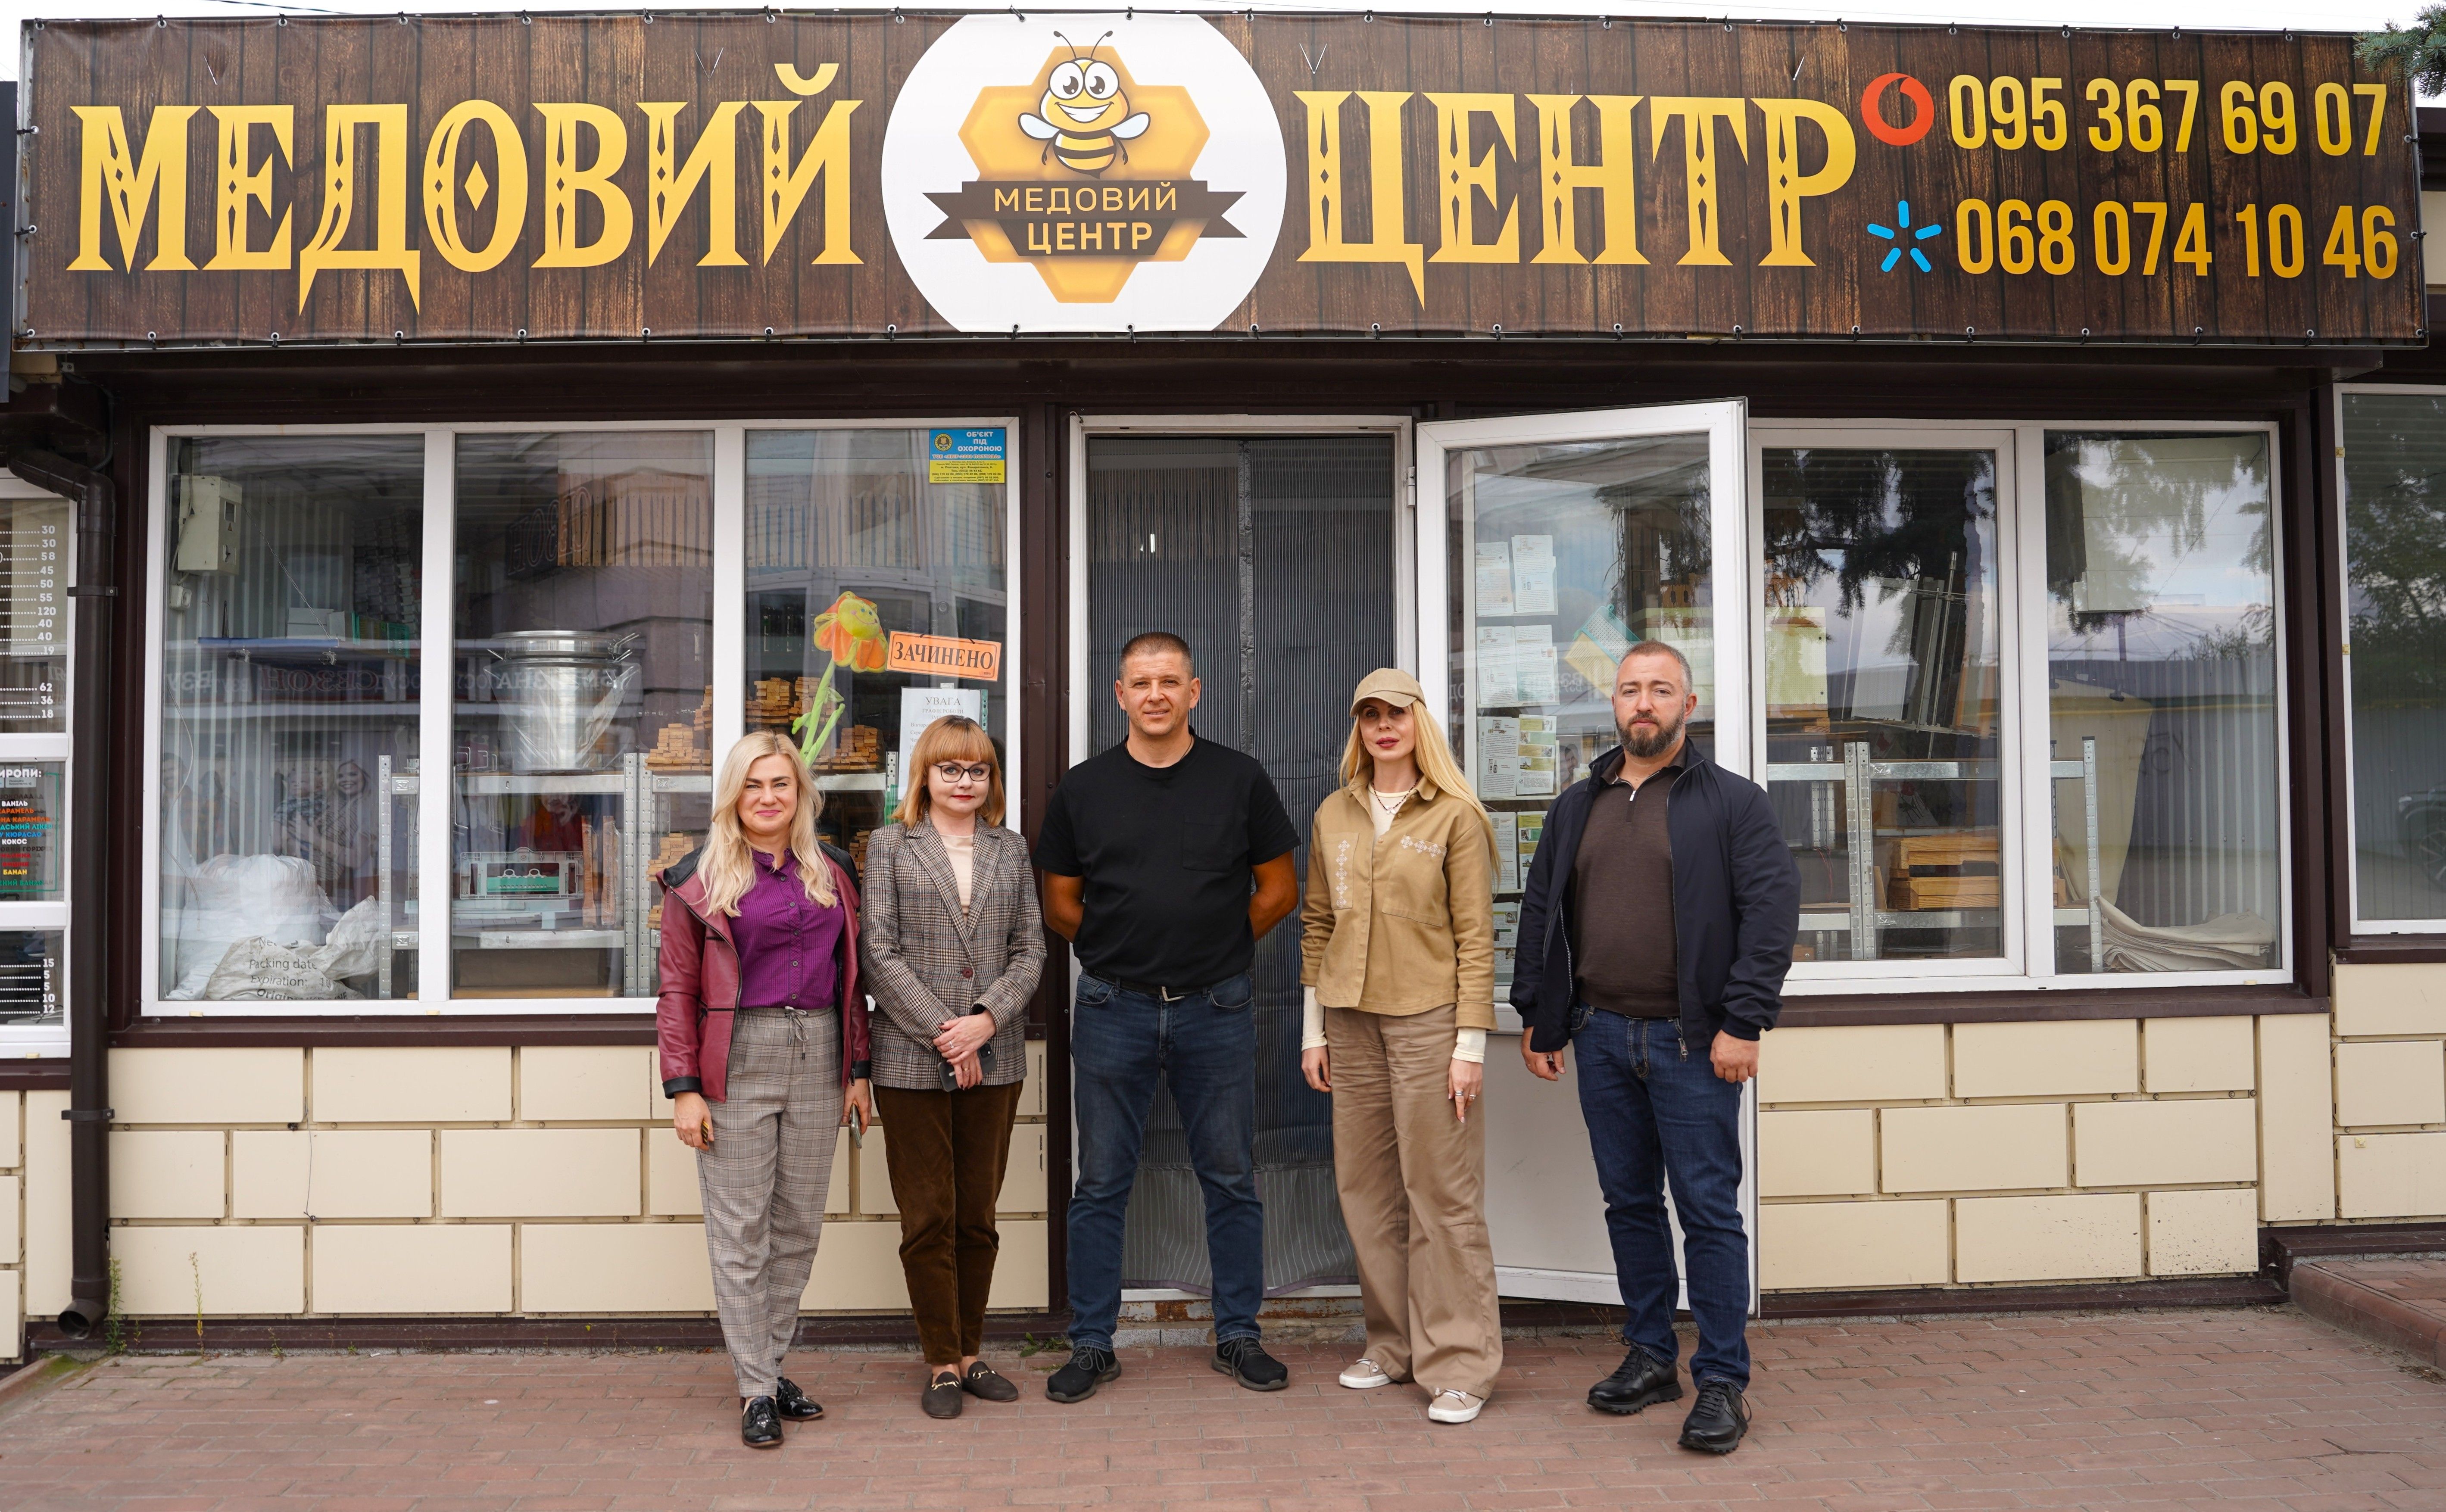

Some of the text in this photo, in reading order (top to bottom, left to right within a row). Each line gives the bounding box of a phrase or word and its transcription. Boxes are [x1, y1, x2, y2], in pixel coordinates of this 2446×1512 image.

[1949, 74, 2387, 156] 095 367 69 07
[66, 63, 1856, 317] МЕДОВИЙ ЦЕНТР
[994, 182, 1177, 215] МЕДОВИЙ
[1028, 222, 1153, 254] ЦЕНТР
[1956, 198, 2398, 280] 068 074 10 46
[41, 525, 55, 534] 30
[42, 539, 56, 548] 30
[41, 552, 55, 561] 58
[40, 566, 54, 575] 45
[40, 579, 53, 588] 50
[40, 593, 53, 602] 55
[37, 607, 56, 616] 120
[38, 619, 53, 628] 40
[37, 632, 52, 641] 40
[43, 646, 55, 655] 19
[893, 642, 993, 669] ЗАЧИНЕНО
[39, 683, 53, 692] 62
[41, 695, 53, 705] 36
[925, 697, 961, 705] УВАГА
[42, 709, 54, 718] 18
[43, 958, 54, 968] 15
[250, 958, 289, 970] Packing
[44, 970, 50, 979] 5
[250, 975, 307, 987] Expiration:
[44, 982, 50, 991] 5
[43, 994, 55, 1003] 10
[43, 1004, 55, 1013] 12
